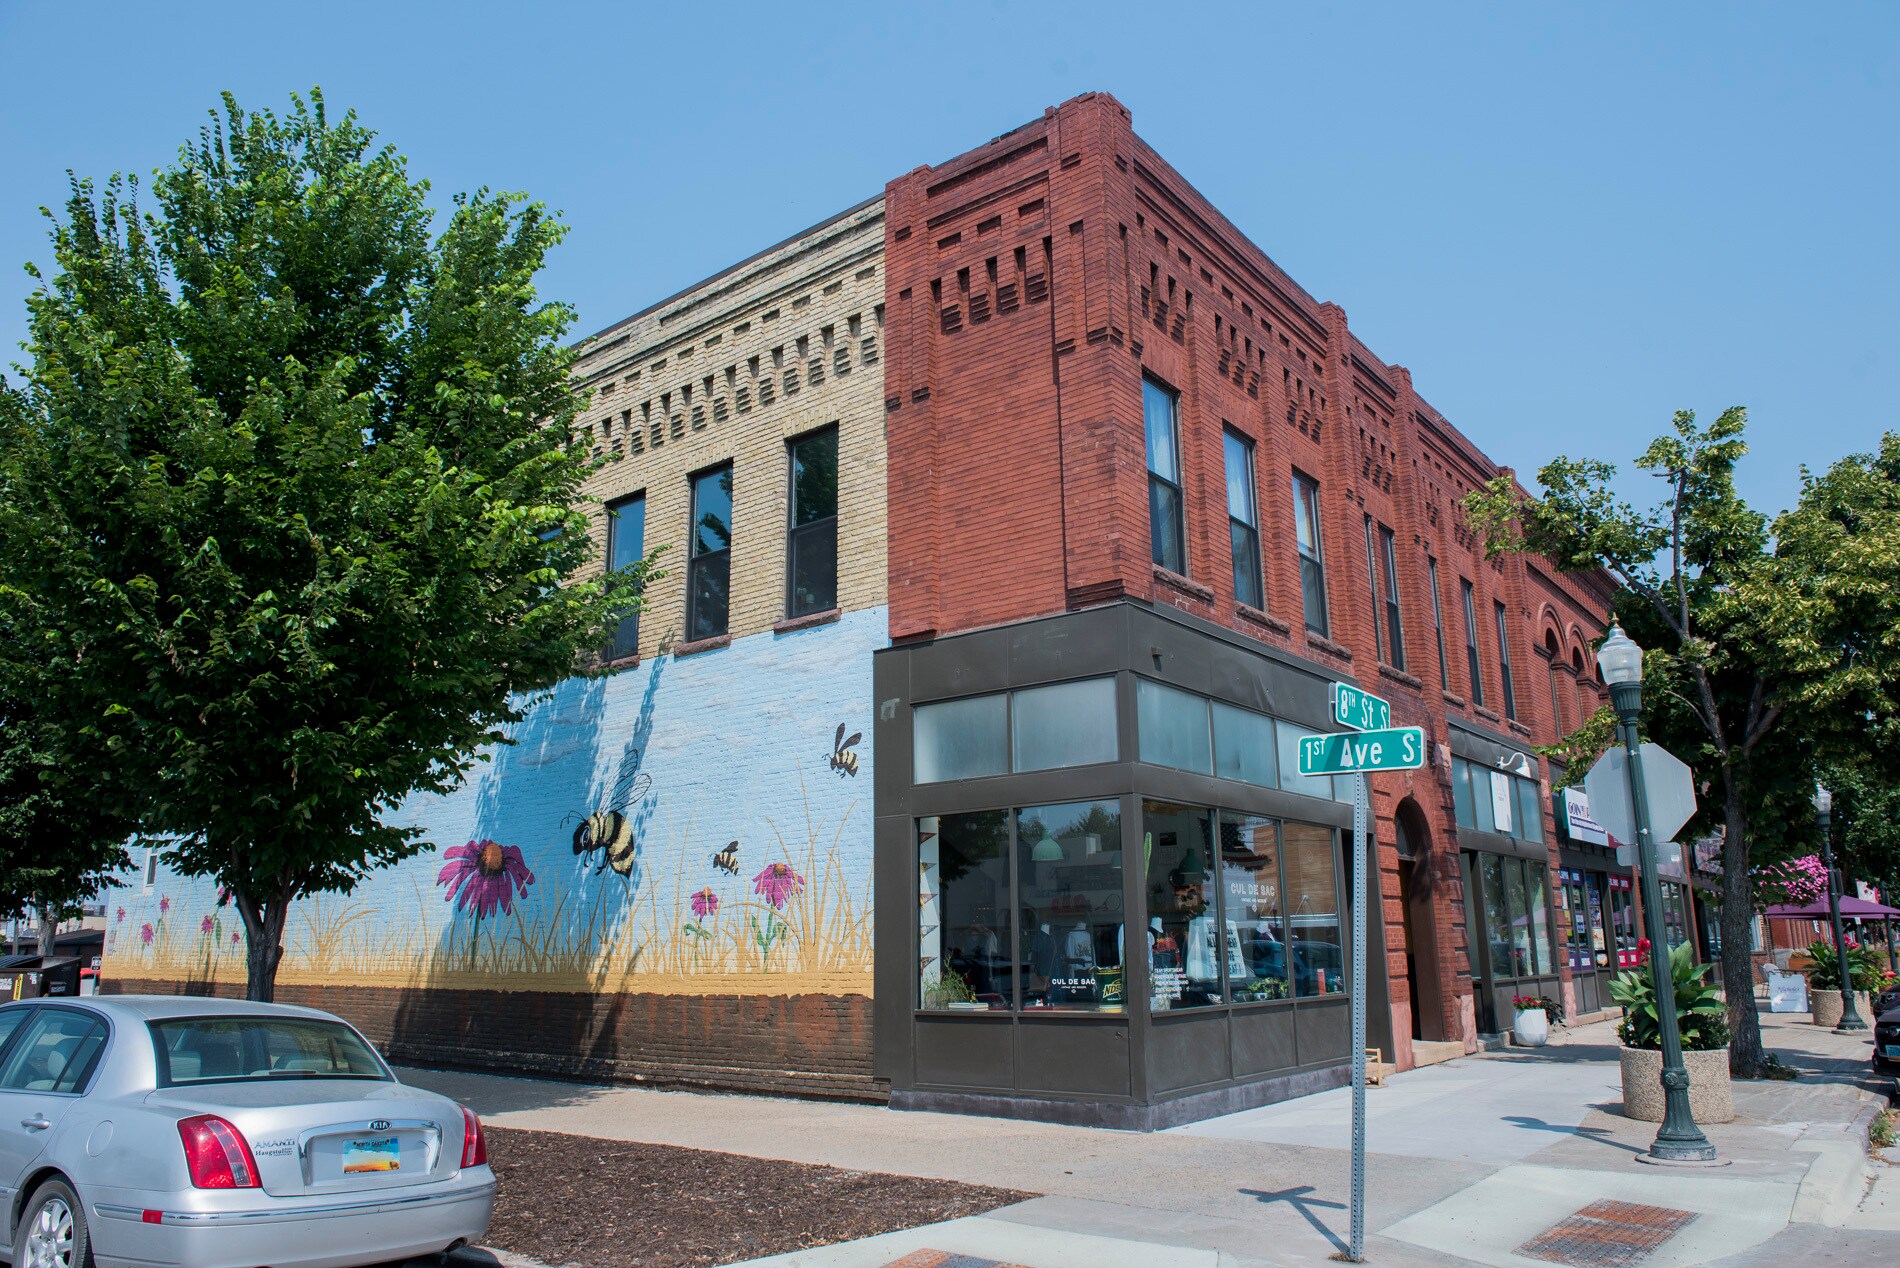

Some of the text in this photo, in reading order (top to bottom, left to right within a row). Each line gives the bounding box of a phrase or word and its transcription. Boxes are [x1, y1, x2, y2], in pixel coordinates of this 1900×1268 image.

[1340, 689, 1387, 730] 8TH St S
[1305, 732, 1416, 770] 1ST Ave S
[1230, 882, 1275, 897] CUL DE SAC
[1103, 983, 1122, 998] NDS
[254, 1139, 295, 1149] AMANTI
